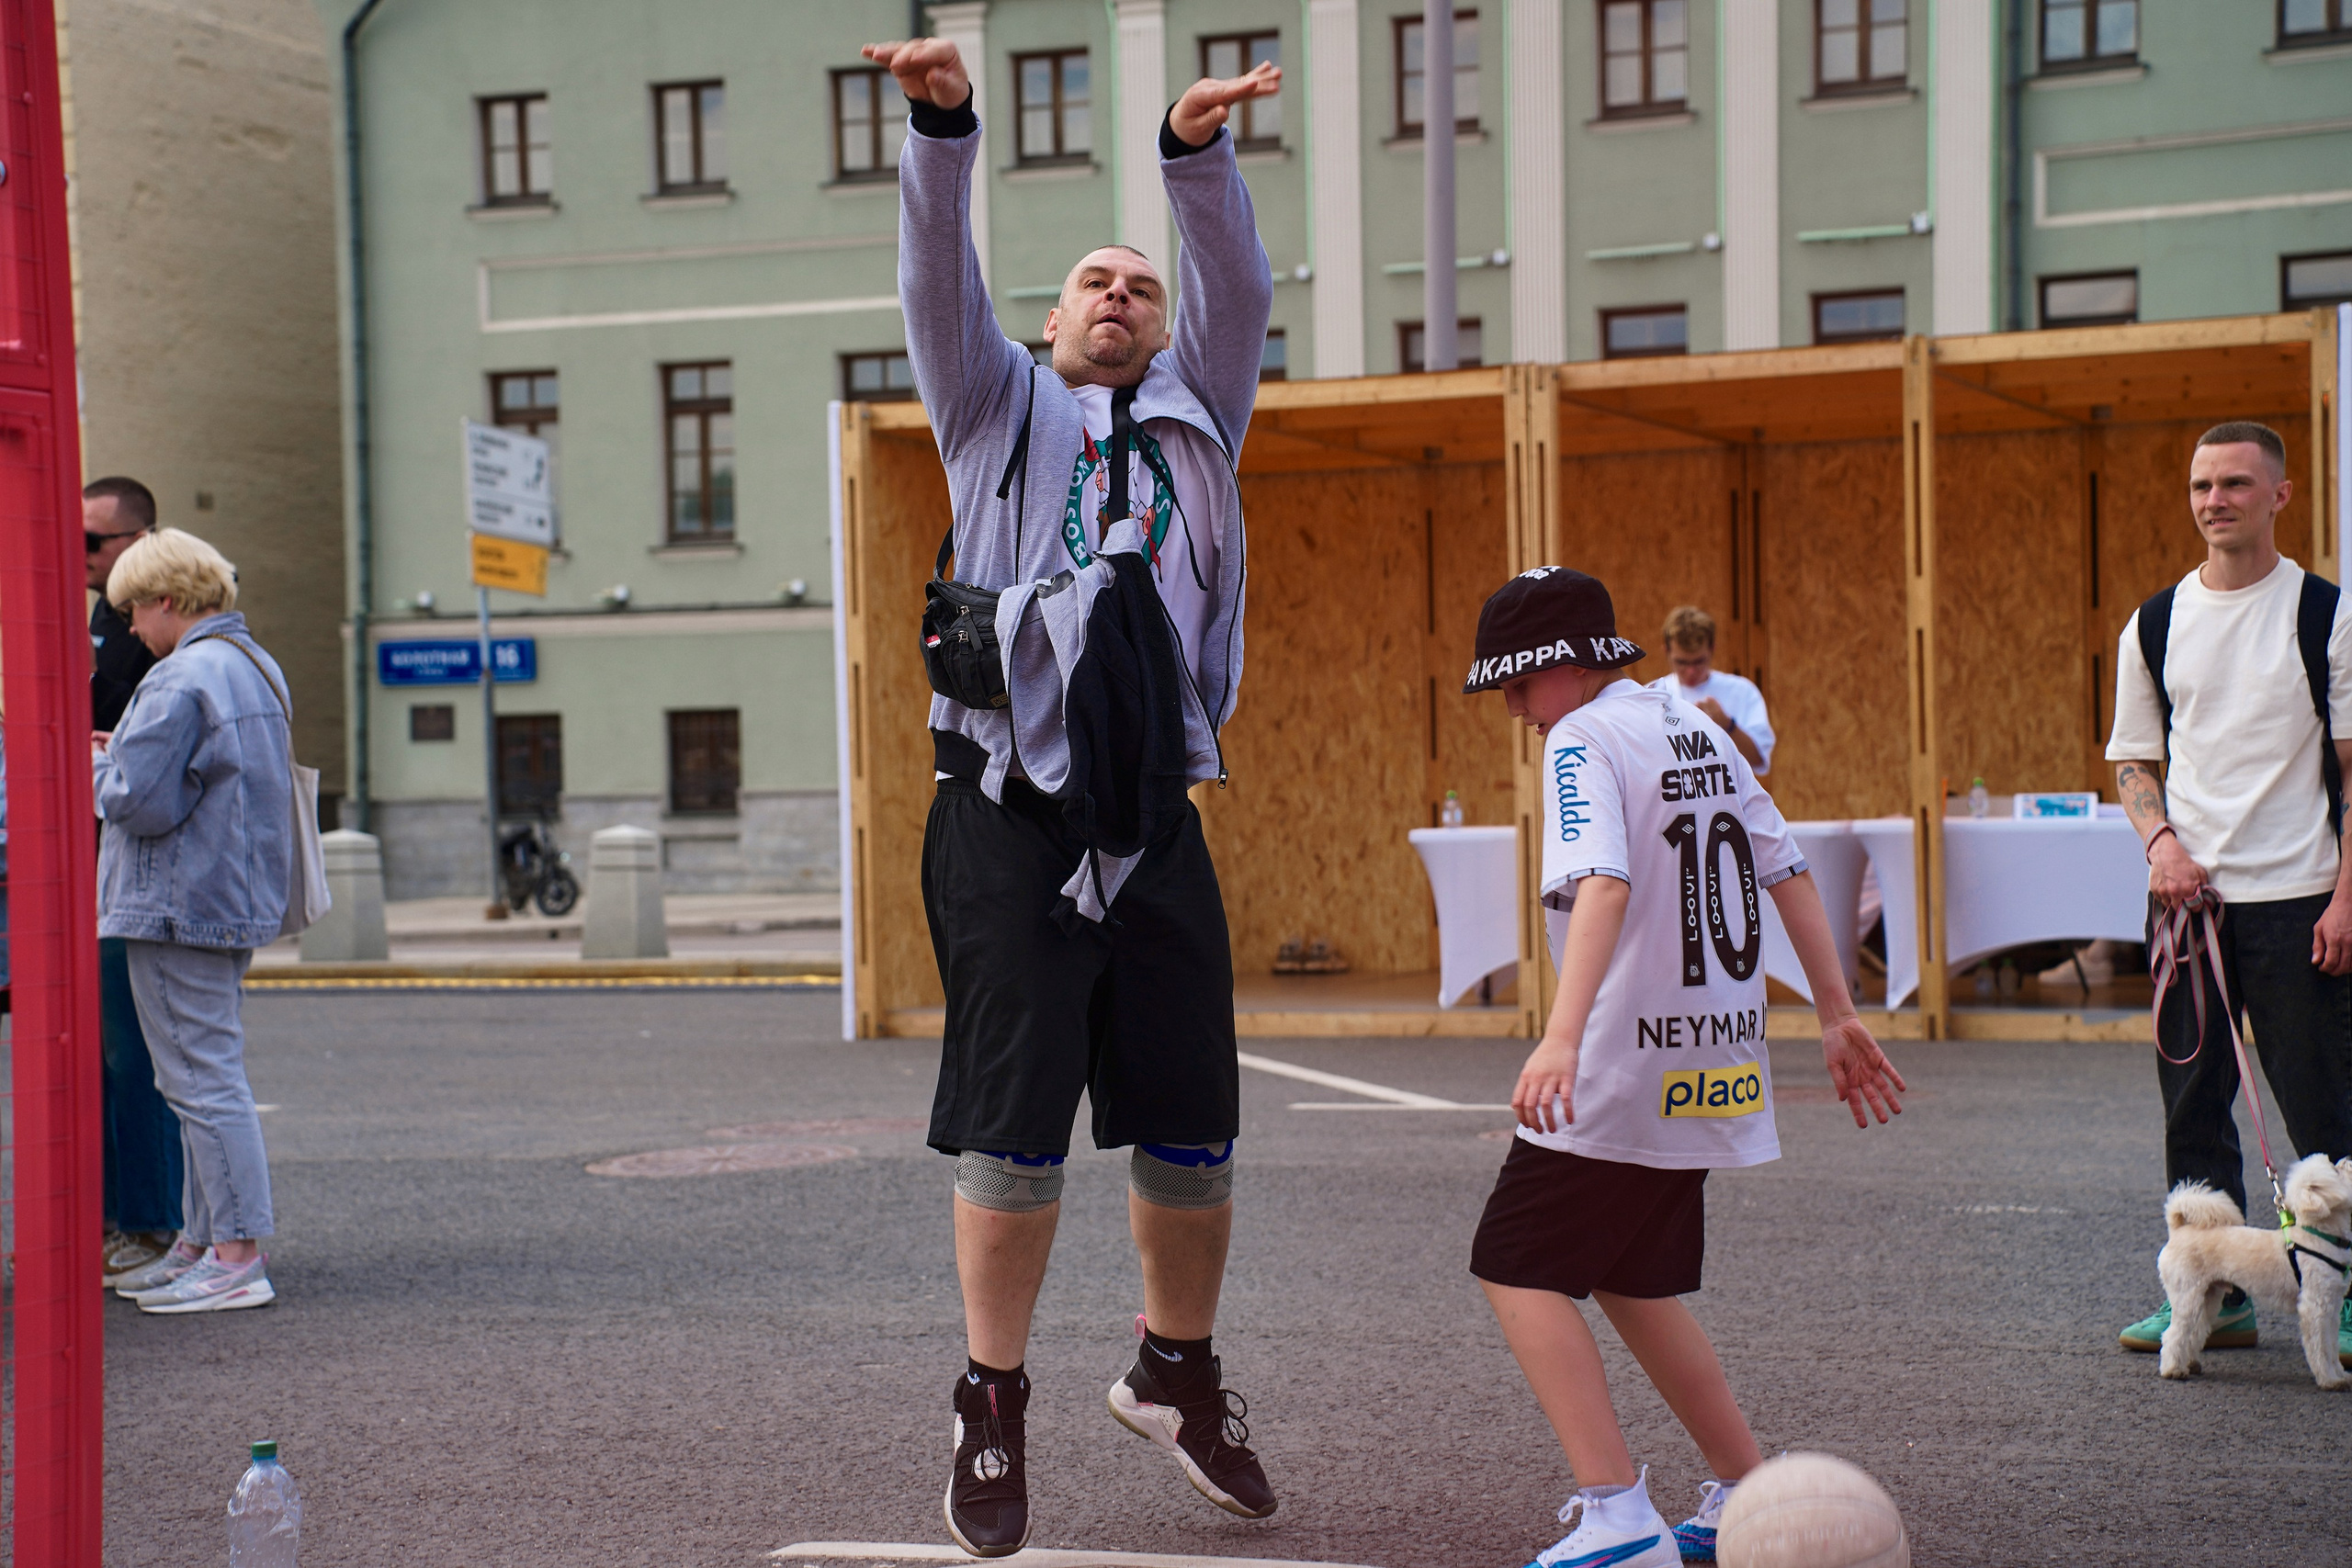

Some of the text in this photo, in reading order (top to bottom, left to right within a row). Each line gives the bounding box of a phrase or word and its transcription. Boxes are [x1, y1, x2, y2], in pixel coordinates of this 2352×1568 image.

[1480, 639, 1577, 684] KAPPA
[1589, 637, 1640, 662] KAP
[1667, 730, 1718, 762] VIVA
[1554, 743, 1591, 842] Kicaldo
[1661, 764, 1737, 802] SORTE
[1662, 811, 1760, 987] 10
[1638, 1010, 1757, 1049] NEYMAR
[1665, 1072, 1760, 1116] placo
